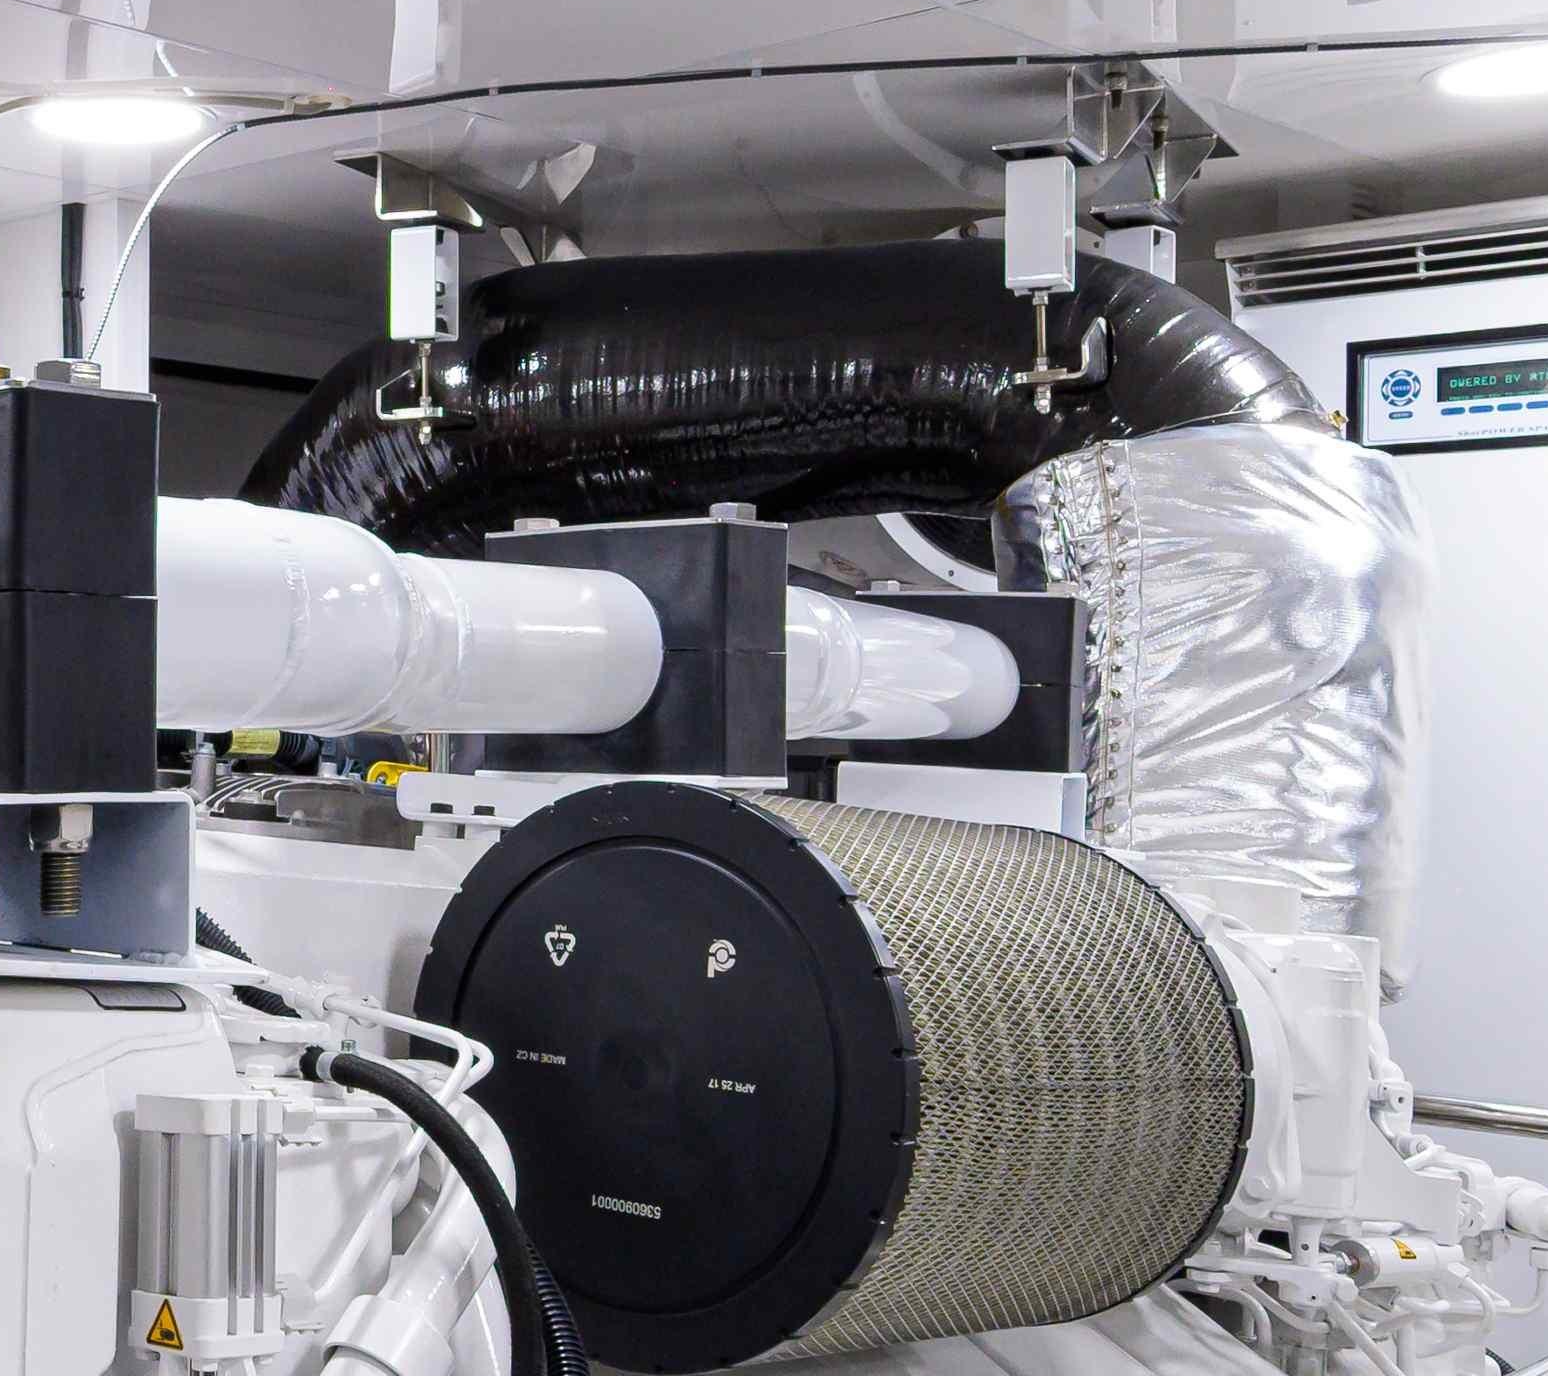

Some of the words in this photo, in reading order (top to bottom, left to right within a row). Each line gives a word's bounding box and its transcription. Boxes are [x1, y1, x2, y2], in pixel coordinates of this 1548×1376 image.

[1504, 373, 1521, 385] BY
[528, 1051, 539, 1062] IN
[540, 1052, 566, 1065] MADE
[707, 1076, 719, 1089] 17
[733, 1079, 756, 1094] APR
[590, 1192, 662, 1220] 5360900001
